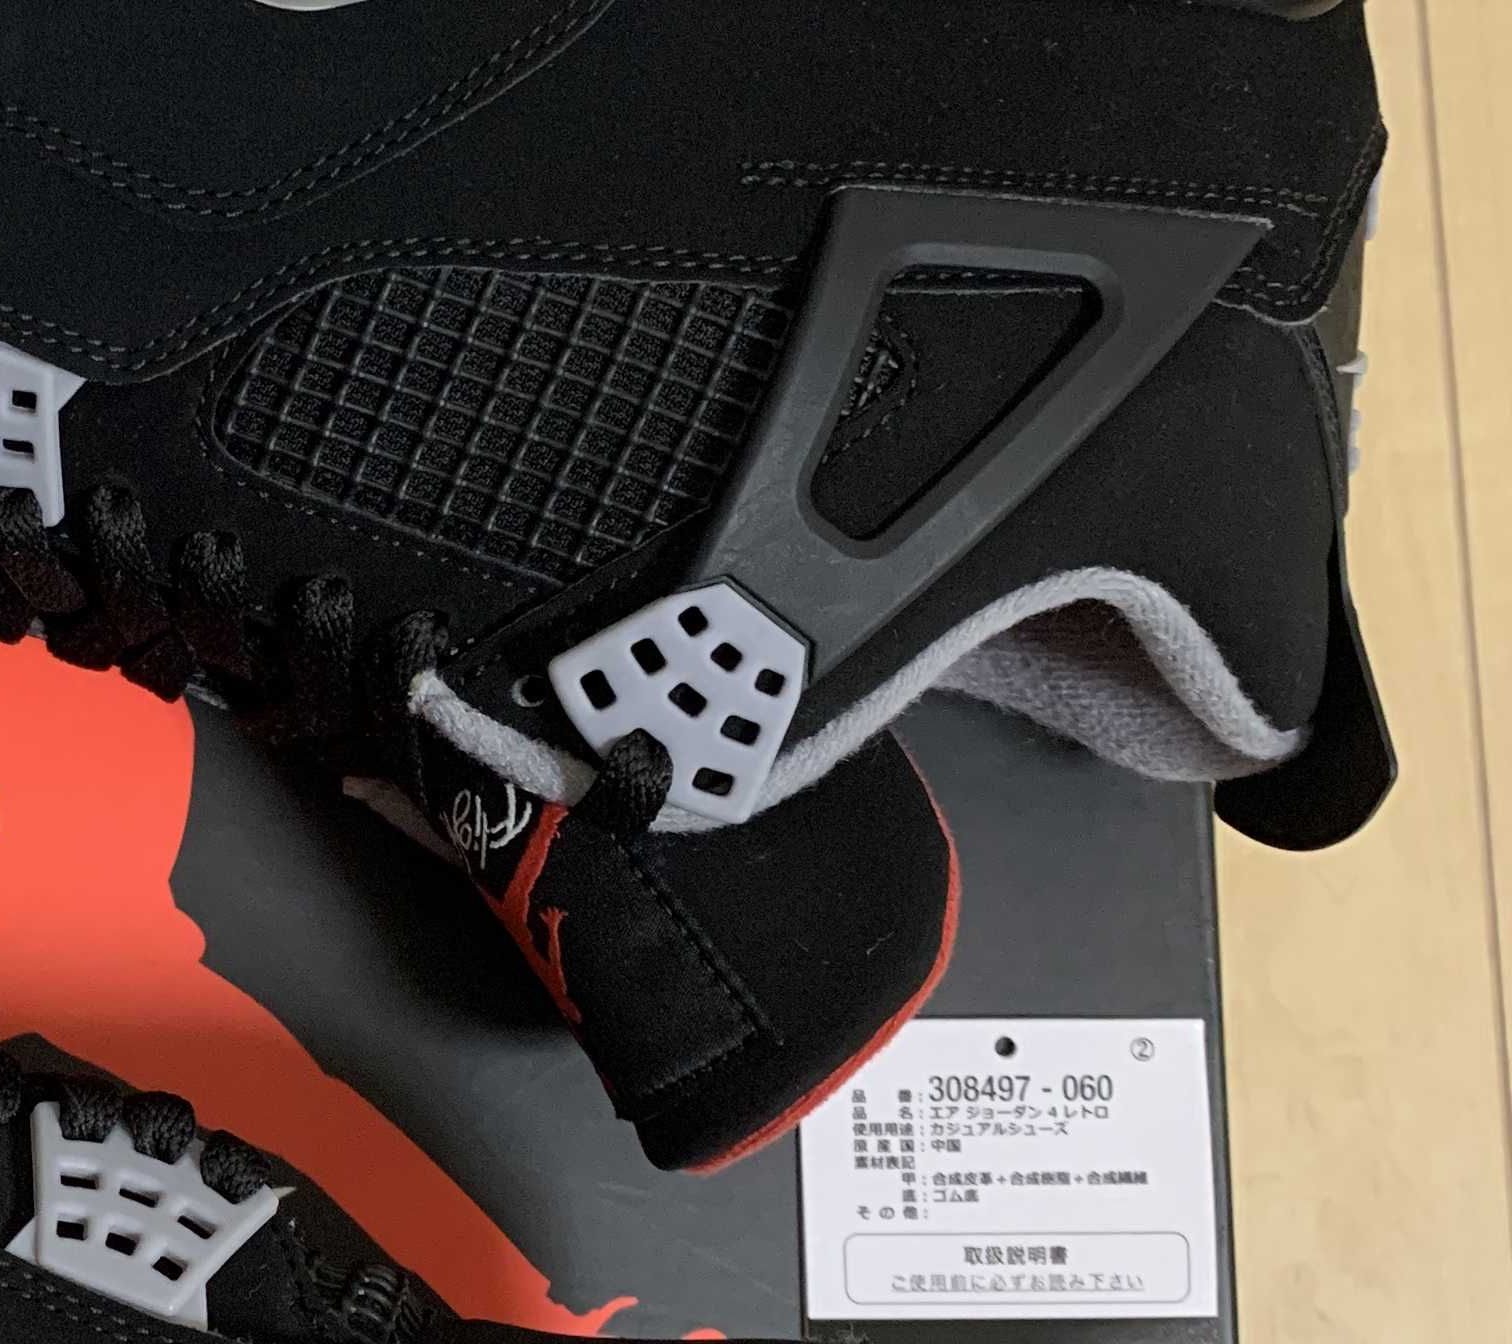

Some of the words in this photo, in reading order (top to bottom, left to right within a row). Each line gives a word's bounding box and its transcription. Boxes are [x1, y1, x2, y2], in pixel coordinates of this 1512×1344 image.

[928, 1076, 1031, 1102] 308497
[1062, 1075, 1113, 1101] 060
[963, 1247, 1068, 1266] 取扱説明書
